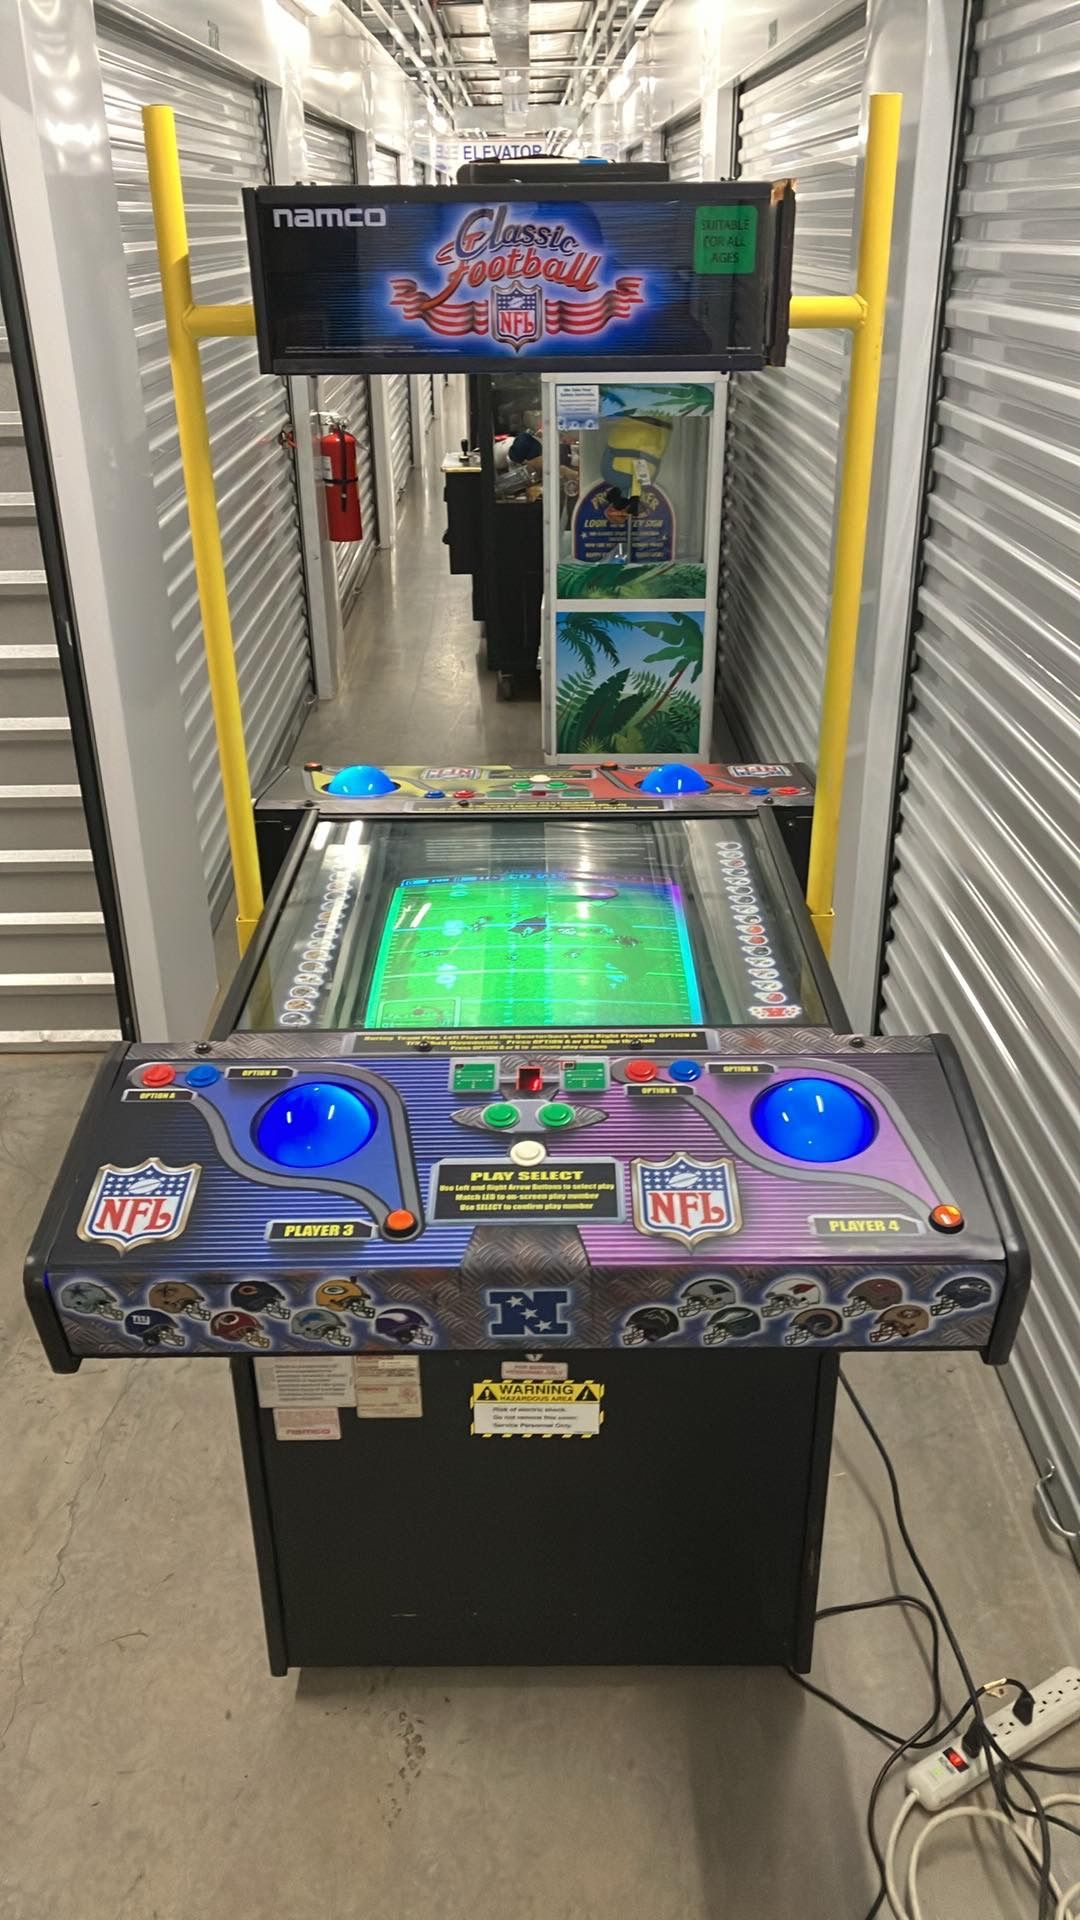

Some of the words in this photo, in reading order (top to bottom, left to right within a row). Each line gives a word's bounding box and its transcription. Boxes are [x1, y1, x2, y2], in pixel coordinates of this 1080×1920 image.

[463, 144, 542, 160] ELEVATOR
[273, 208, 387, 228] namco
[455, 204, 580, 260] Classic
[499, 311, 534, 336] NFL
[241, 1069, 271, 1077] OPTION
[723, 1065, 751, 1073] OPTION
[139, 1092, 167, 1100] OPTION
[641, 1087, 671, 1095] OPTION
[470, 1171, 515, 1182] PLAY
[518, 1170, 584, 1181] SELECT
[471, 1184, 485, 1192] and
[497, 1193, 506, 1201] to
[567, 1192, 599, 1200] number
[513, 1203, 543, 1211] confirm
[648, 1191, 724, 1228] NFL
[95, 1197, 174, 1235] NFL
[283, 1223, 341, 1238] PLAYER
[341, 1223, 355, 1237] 3
[829, 1219, 886, 1233] PLAYER
[887, 1219, 900, 1232] 4
[500, 1385, 574, 1395] WARNING
